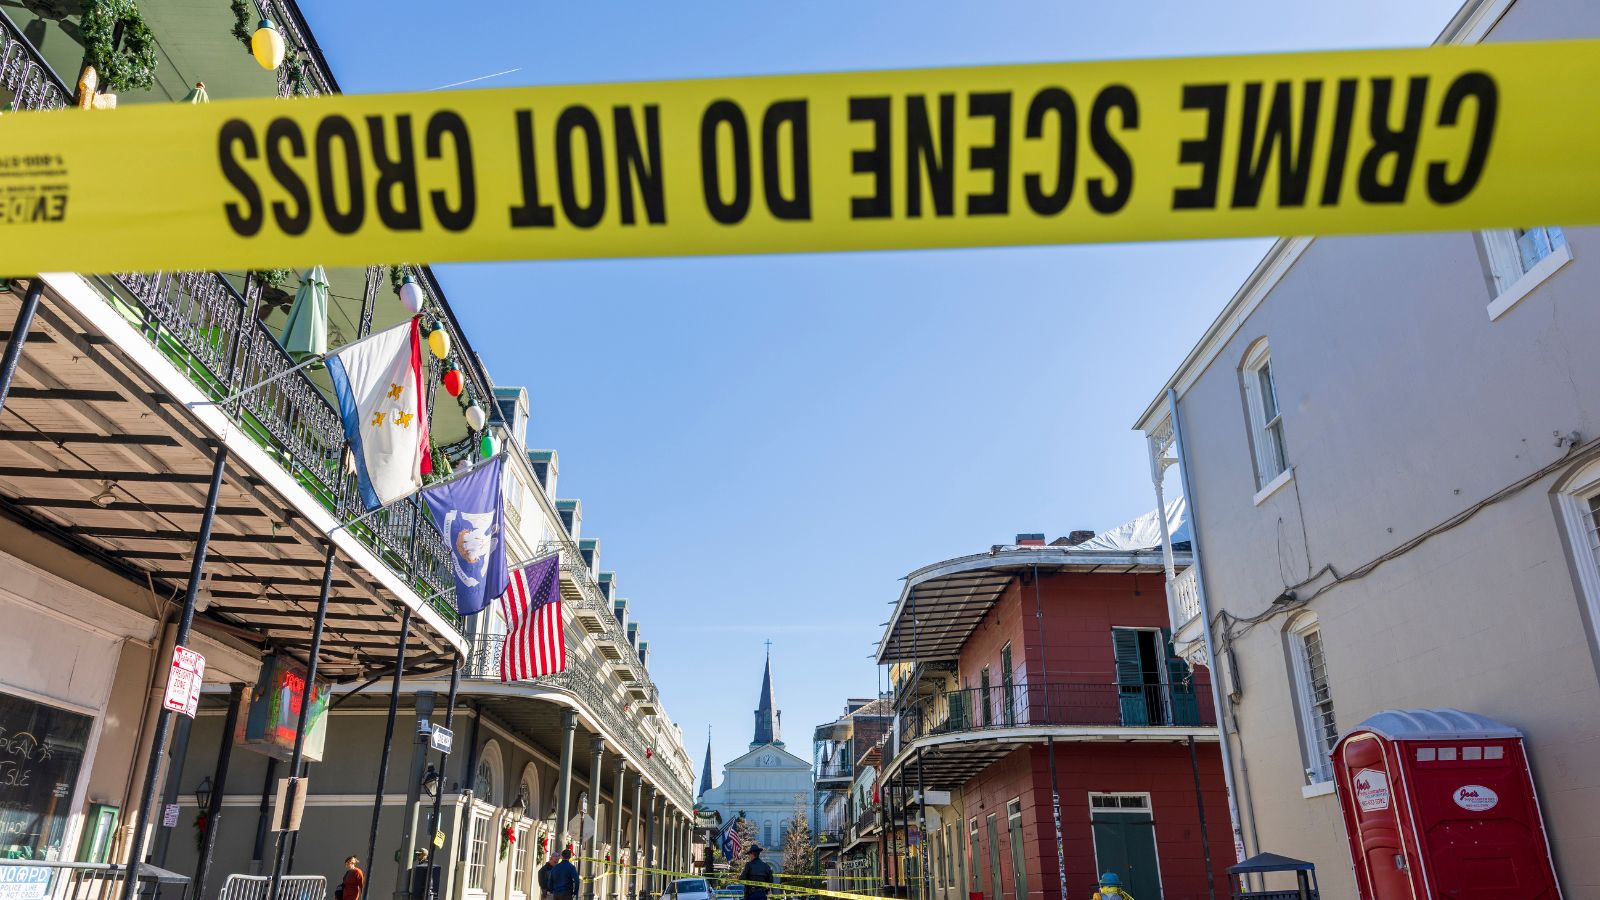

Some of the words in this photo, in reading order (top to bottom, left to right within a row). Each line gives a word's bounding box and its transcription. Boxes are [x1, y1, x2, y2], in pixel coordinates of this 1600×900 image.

[218, 109, 477, 238] CROSS
[508, 104, 667, 230] NOT
[700, 98, 812, 226] DO
[848, 83, 1140, 219] SCENE
[1172, 70, 1499, 212] CRIME
[173, 678, 187, 690] ZONE
[1356, 778, 1371, 797] Joe's
[1459, 788, 1479, 800] Joe's
[0, 884, 22, 892] POLICE
[25, 884, 38, 892] LINE
